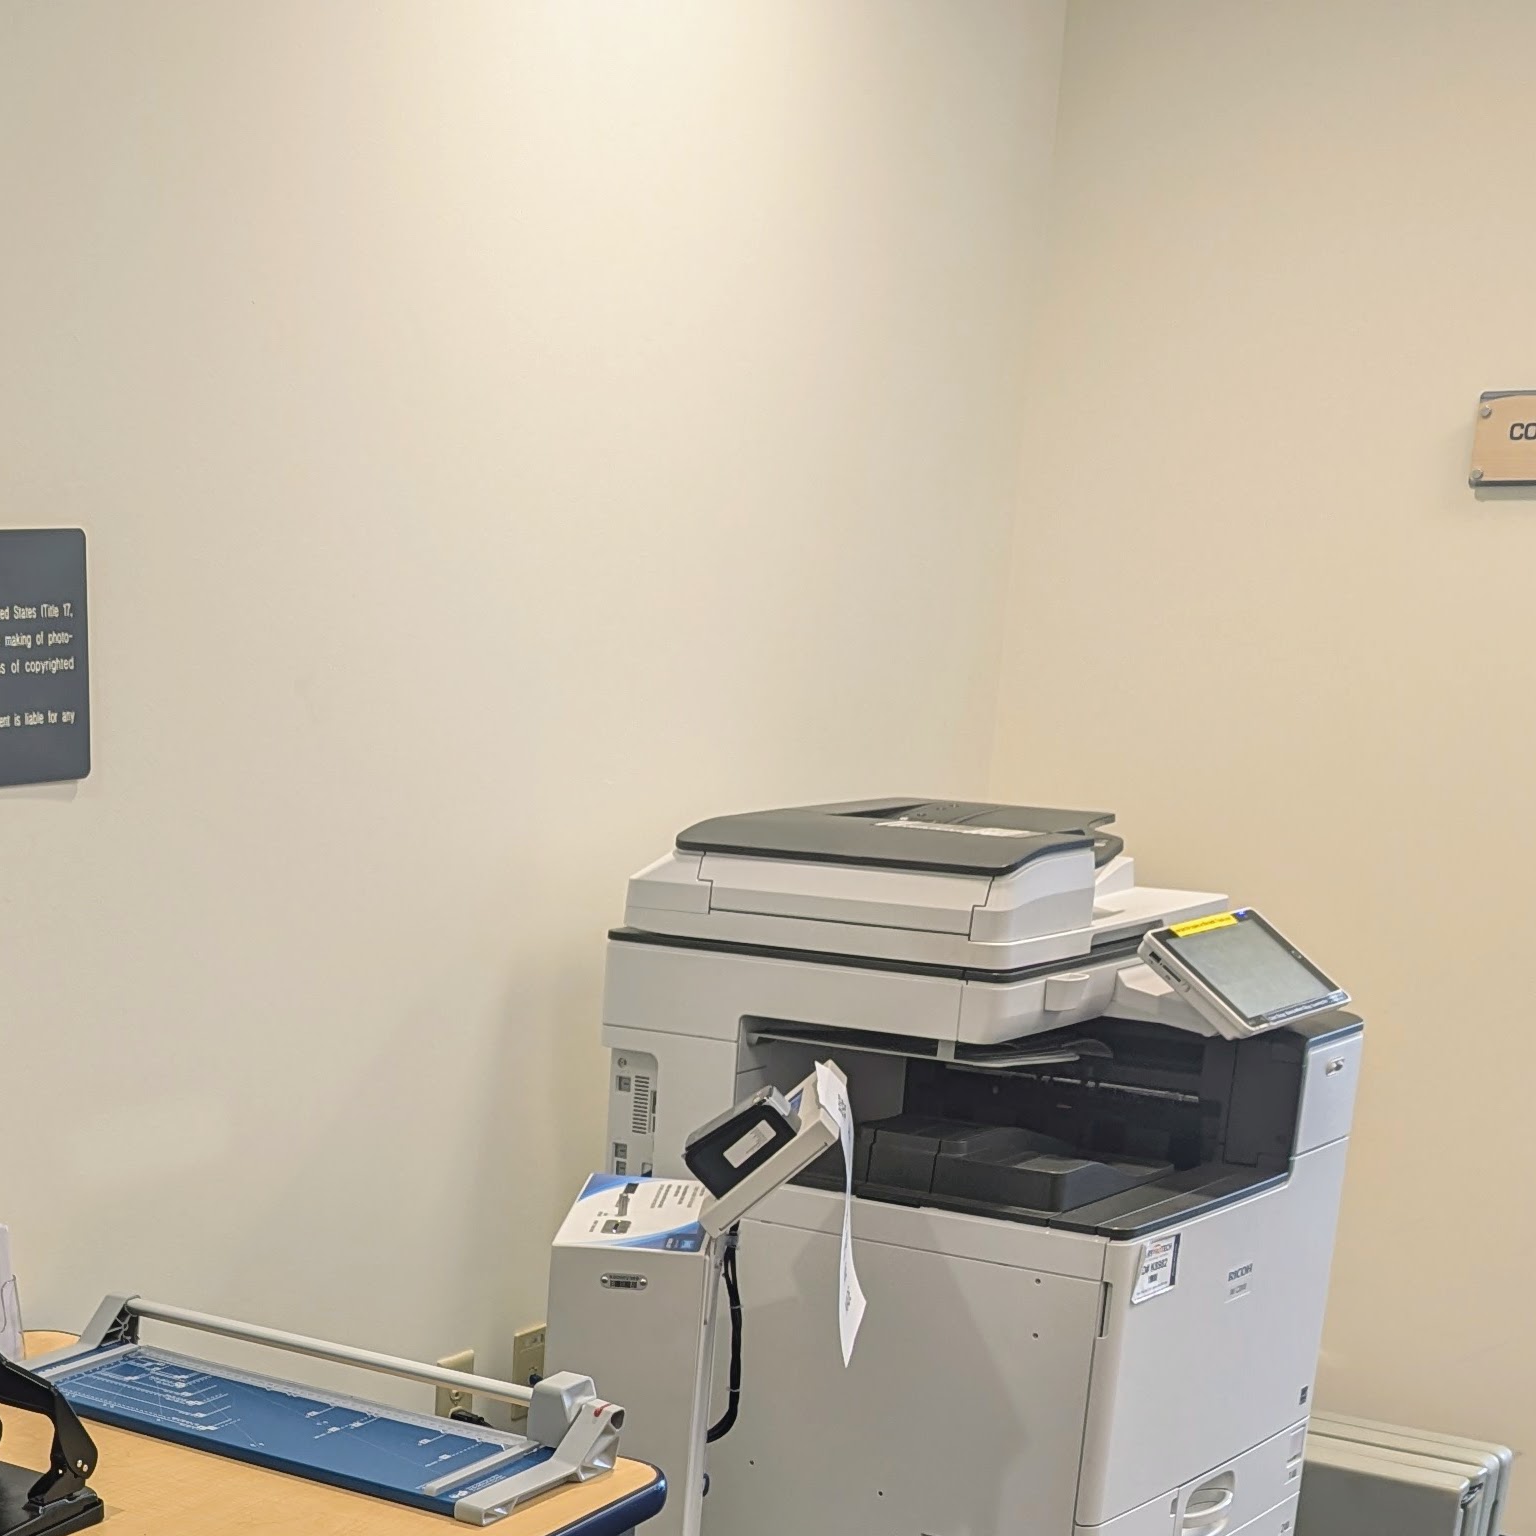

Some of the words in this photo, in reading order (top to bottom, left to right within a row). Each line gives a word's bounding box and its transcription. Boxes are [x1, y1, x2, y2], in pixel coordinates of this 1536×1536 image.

[14, 605, 37, 619] States
[4, 633, 32, 648] making
[36, 631, 44, 645] of
[48, 632, 73, 647] photo-
[11, 660, 20, 674] of
[25, 656, 75, 674] copyrighted
[14, 712, 21, 727] is
[25, 711, 44, 725] liable
[48, 710, 58, 724] for
[62, 711, 75, 725] any
[1228, 1263, 1253, 1282] RICOH
